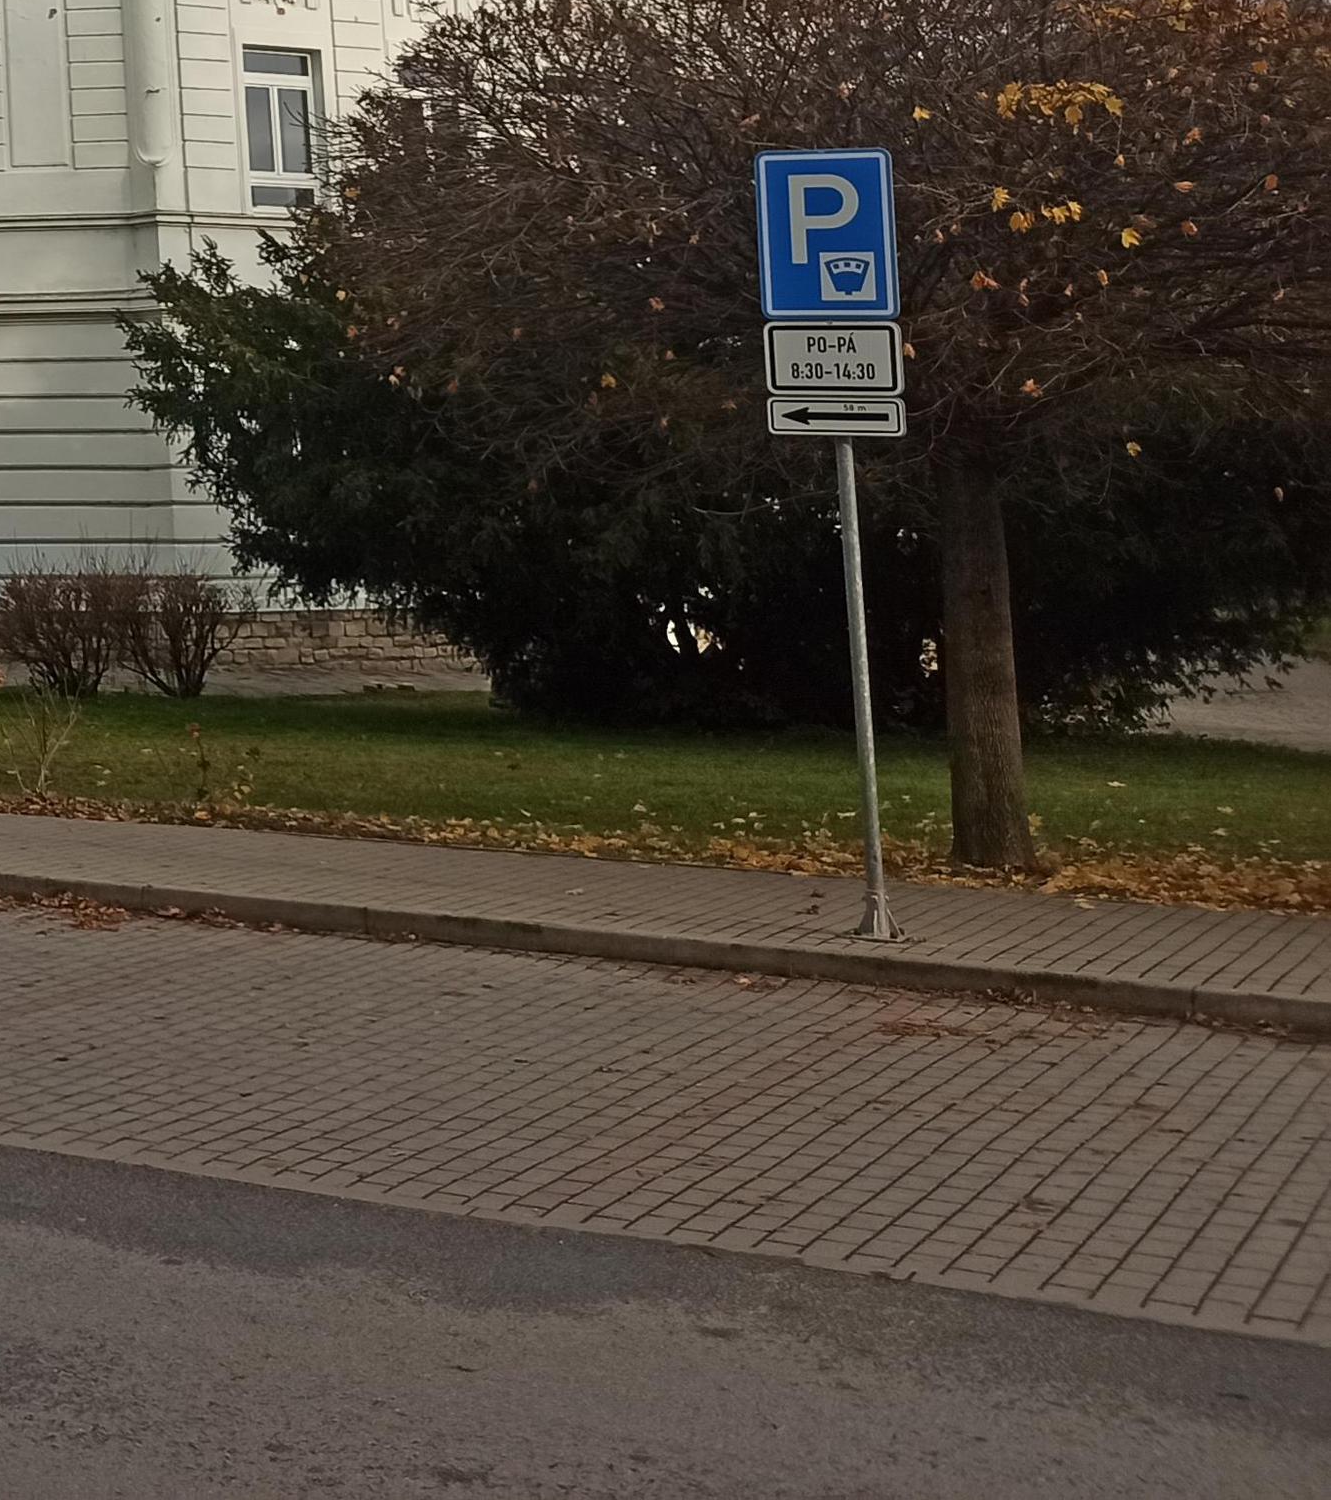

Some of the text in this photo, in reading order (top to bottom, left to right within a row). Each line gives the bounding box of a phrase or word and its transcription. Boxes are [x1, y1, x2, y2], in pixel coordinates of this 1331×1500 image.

[787, 174, 860, 264] P
[807, 332, 857, 353] PO-PÁ
[791, 362, 876, 380] 8:30-14:30
